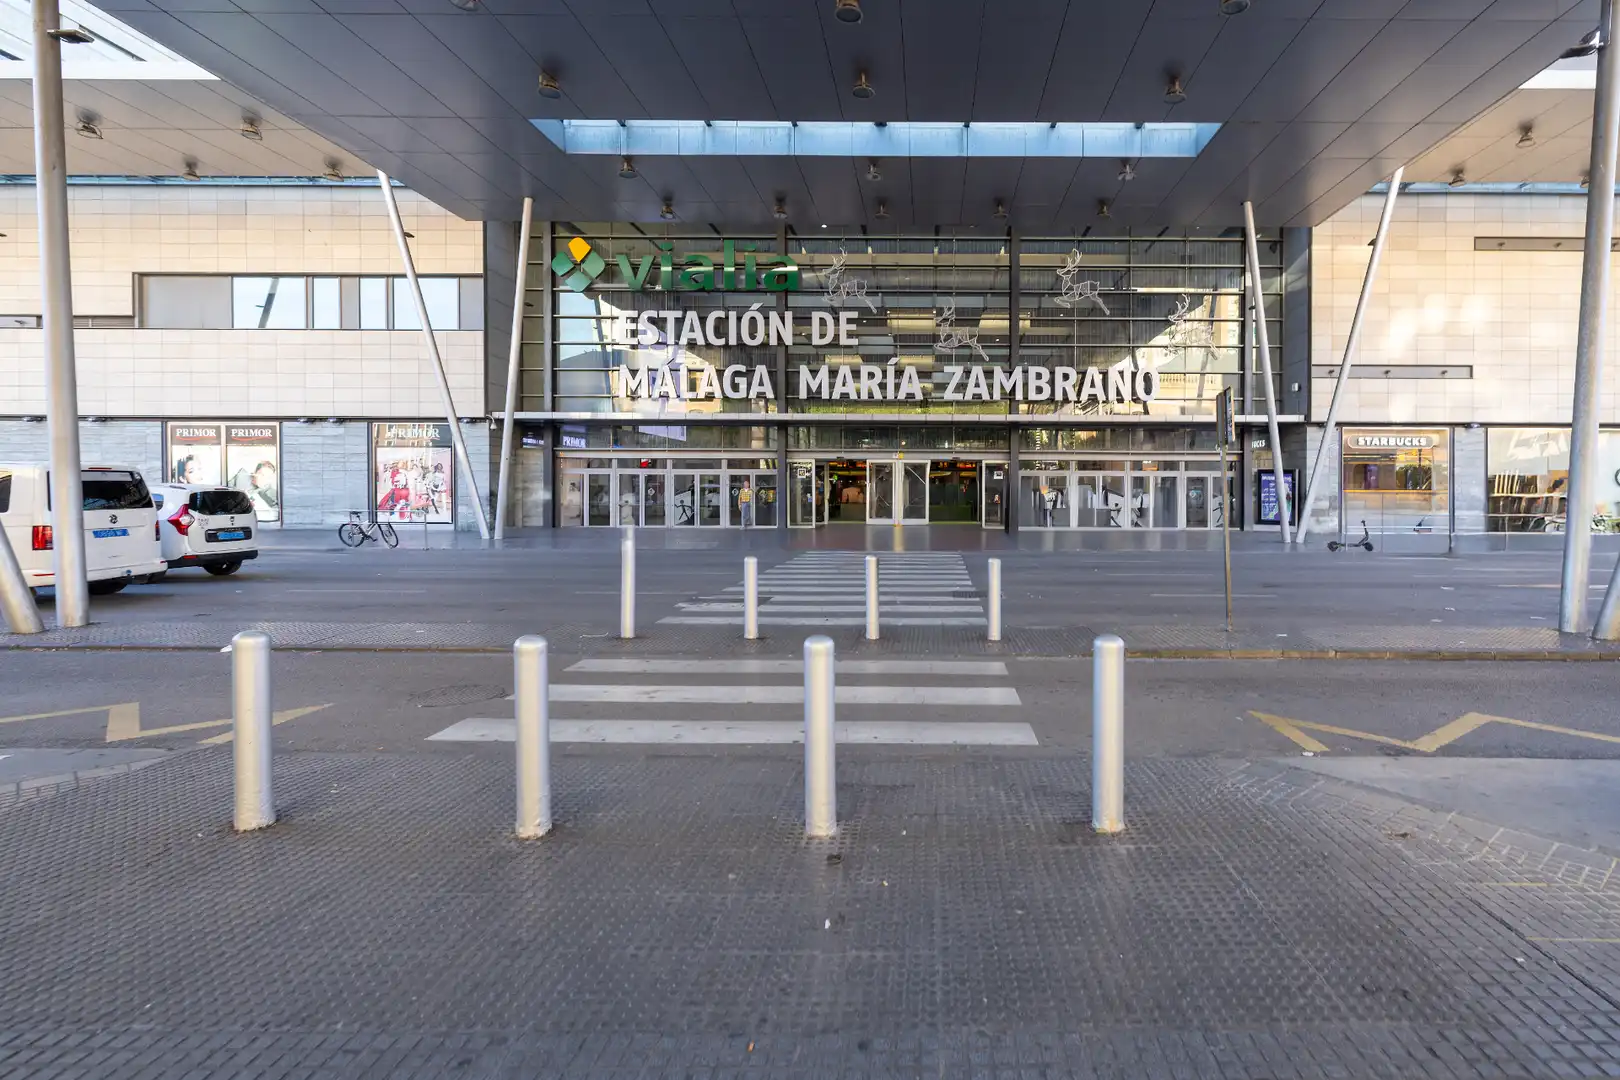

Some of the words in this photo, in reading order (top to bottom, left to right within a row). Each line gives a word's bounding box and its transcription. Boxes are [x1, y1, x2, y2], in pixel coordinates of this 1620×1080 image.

[616, 240, 799, 291] vialia
[618, 303, 793, 346] ESTACIÓN
[811, 311, 859, 346] DE
[618, 357, 775, 399] MÁLAGA
[798, 357, 924, 400] MARÍA
[943, 365, 1161, 401] ZAMBRANO
[176, 428, 216, 437] PRIMOR
[231, 428, 273, 437] PRIMOR
[1358, 436, 1427, 446] STARBUCKS
